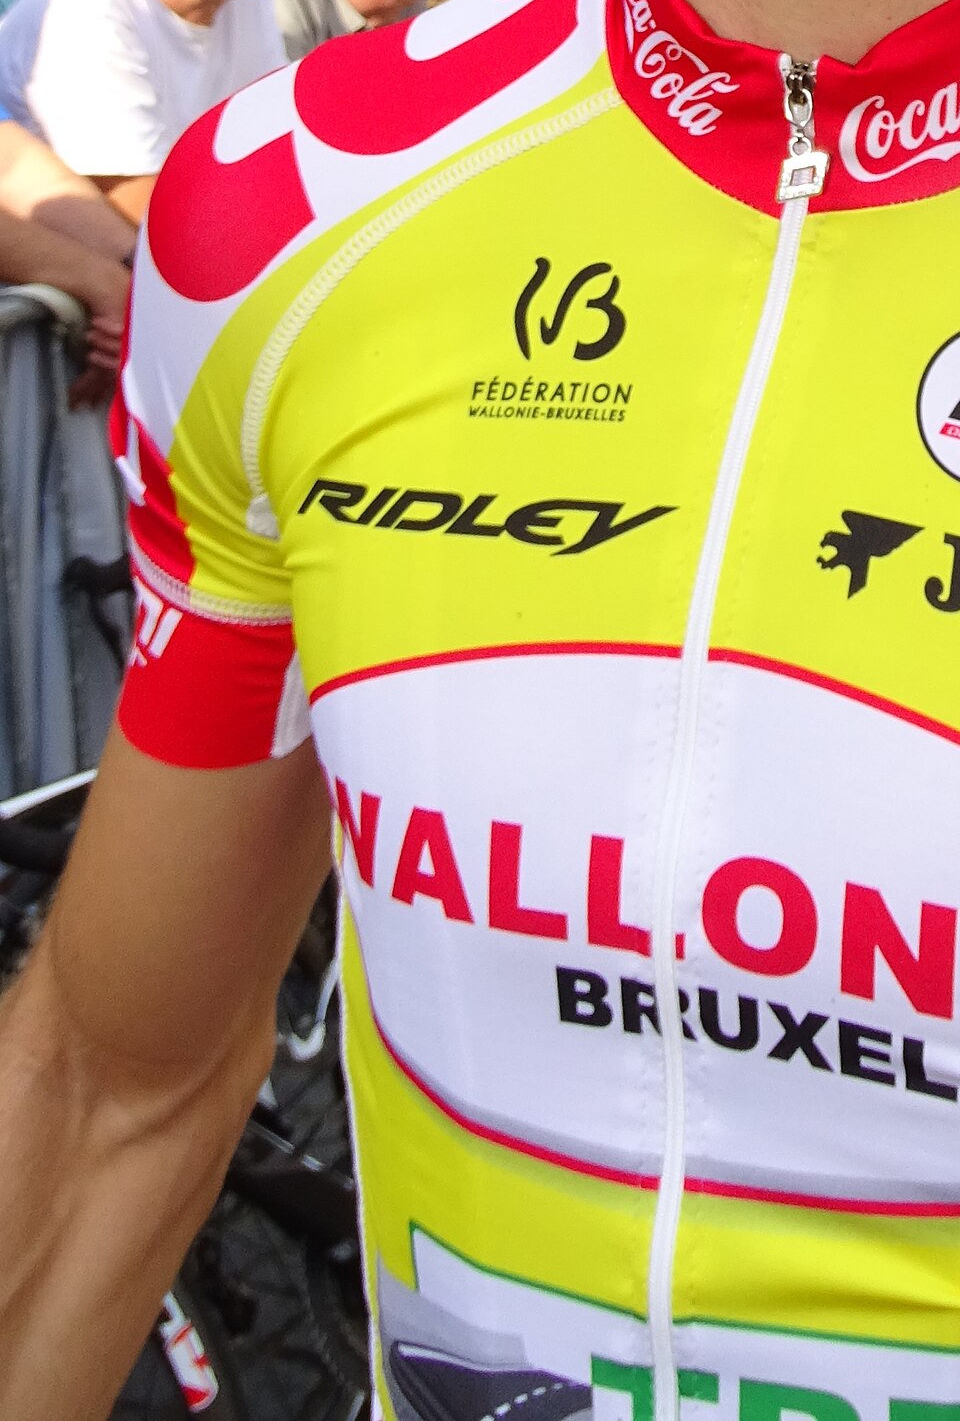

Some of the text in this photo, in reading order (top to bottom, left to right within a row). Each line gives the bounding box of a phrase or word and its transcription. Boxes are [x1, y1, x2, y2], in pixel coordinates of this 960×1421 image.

[471, 376, 633, 404] FÉDÉRATION
[468, 405, 627, 422] WALLONIE-BRUXELLES
[298, 479, 680, 557] RIDLEY
